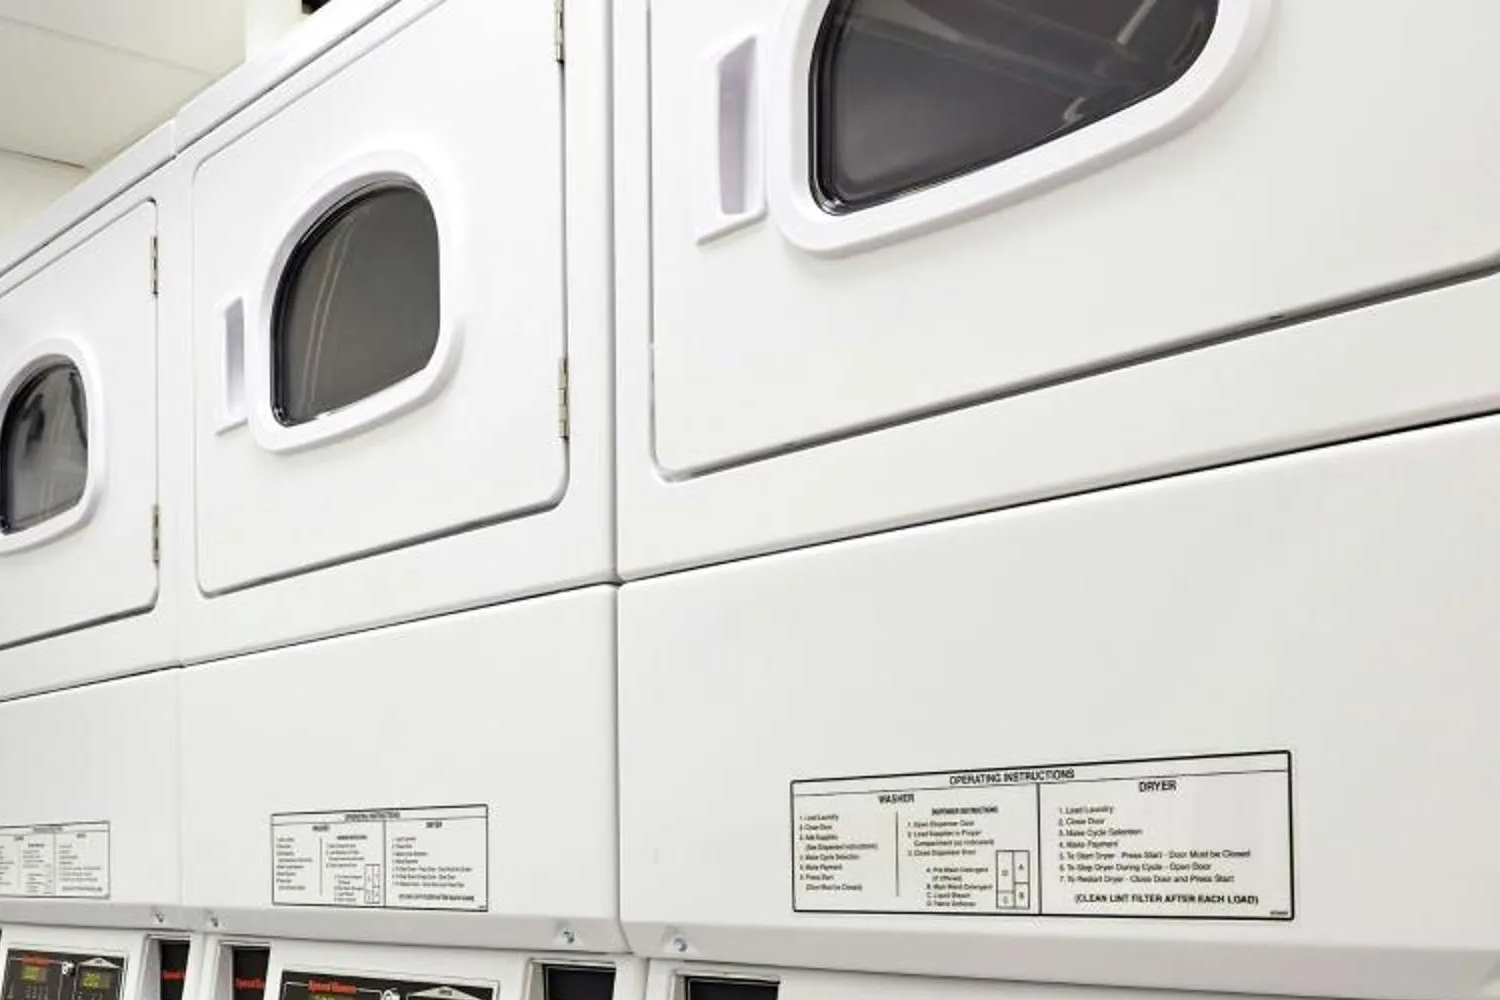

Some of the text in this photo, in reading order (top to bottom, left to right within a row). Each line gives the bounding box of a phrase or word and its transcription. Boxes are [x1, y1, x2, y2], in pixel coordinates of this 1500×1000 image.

[949, 768, 1075, 785] OPERATING INSTRUCTIONS
[1138, 780, 1177, 793] DRYER
